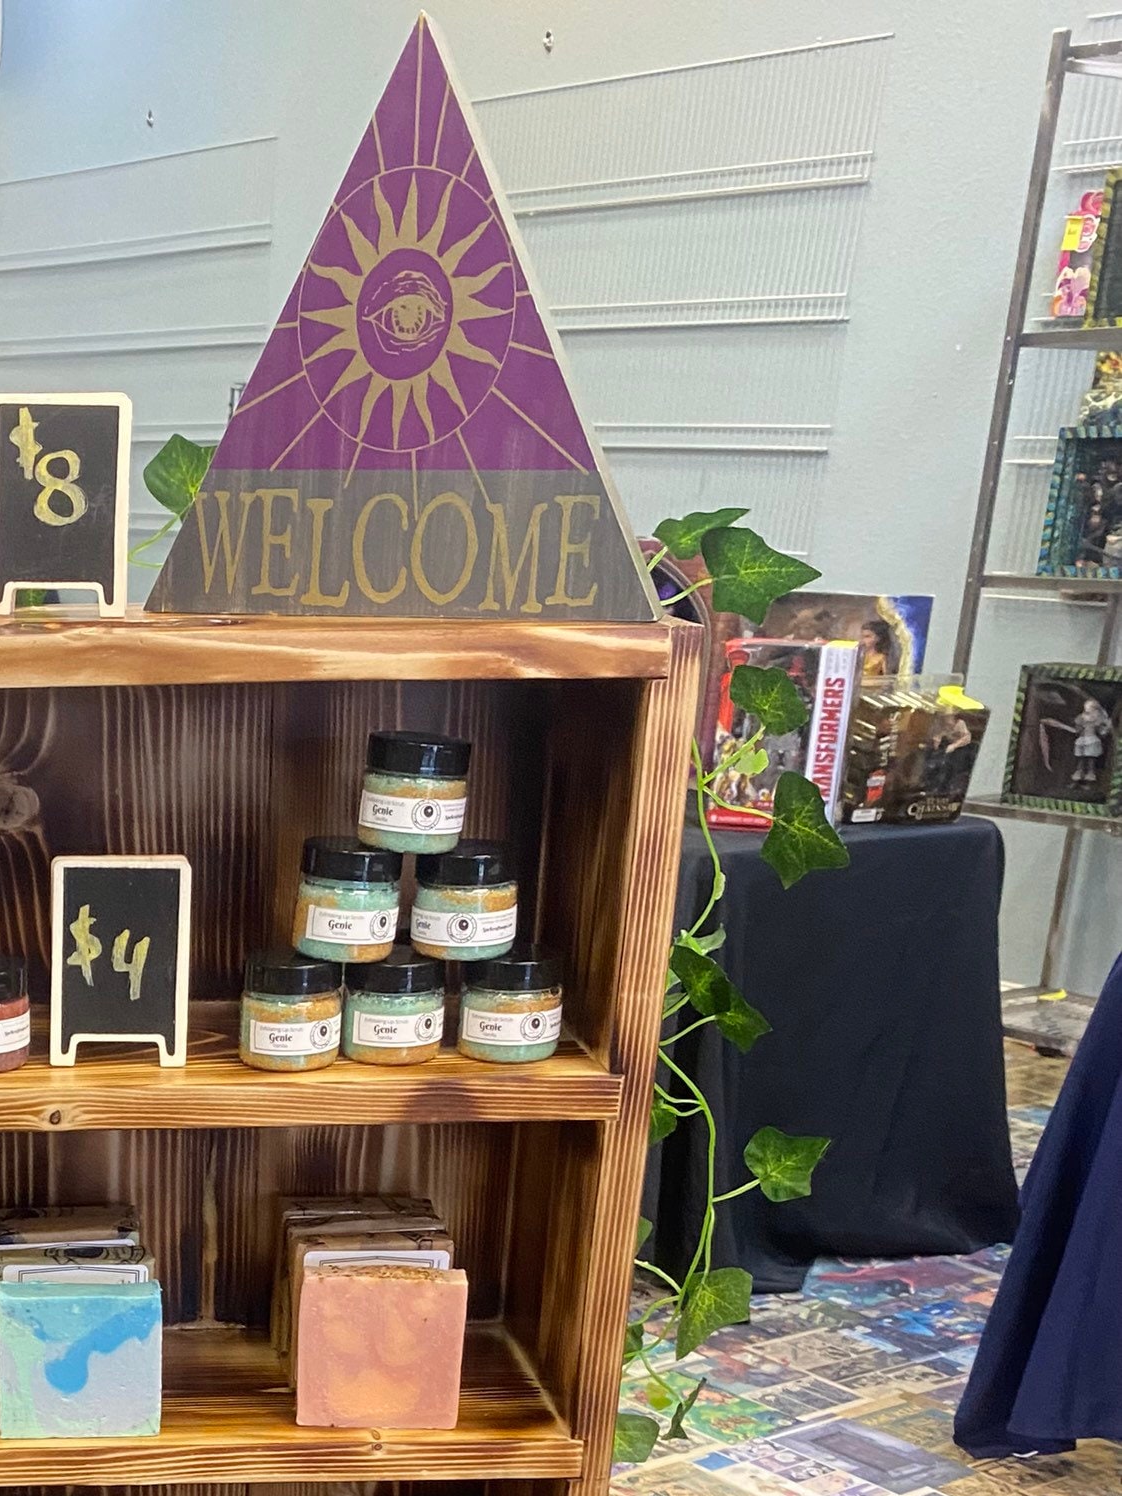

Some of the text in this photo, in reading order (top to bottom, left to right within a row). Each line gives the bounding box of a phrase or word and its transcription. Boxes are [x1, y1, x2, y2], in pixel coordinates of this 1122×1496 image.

[9, 407, 88, 527] $8
[195, 488, 601, 613] WELCOME
[812, 677, 846, 801] RANSFORMERS
[372, 804, 394, 816] Genie
[328, 920, 353, 930] Genie
[66, 903, 151, 1001] $4
[373, 1024, 398, 1036] Genie
[479, 1021, 502, 1032] Genie
[268, 1032, 293, 1043] Genie
